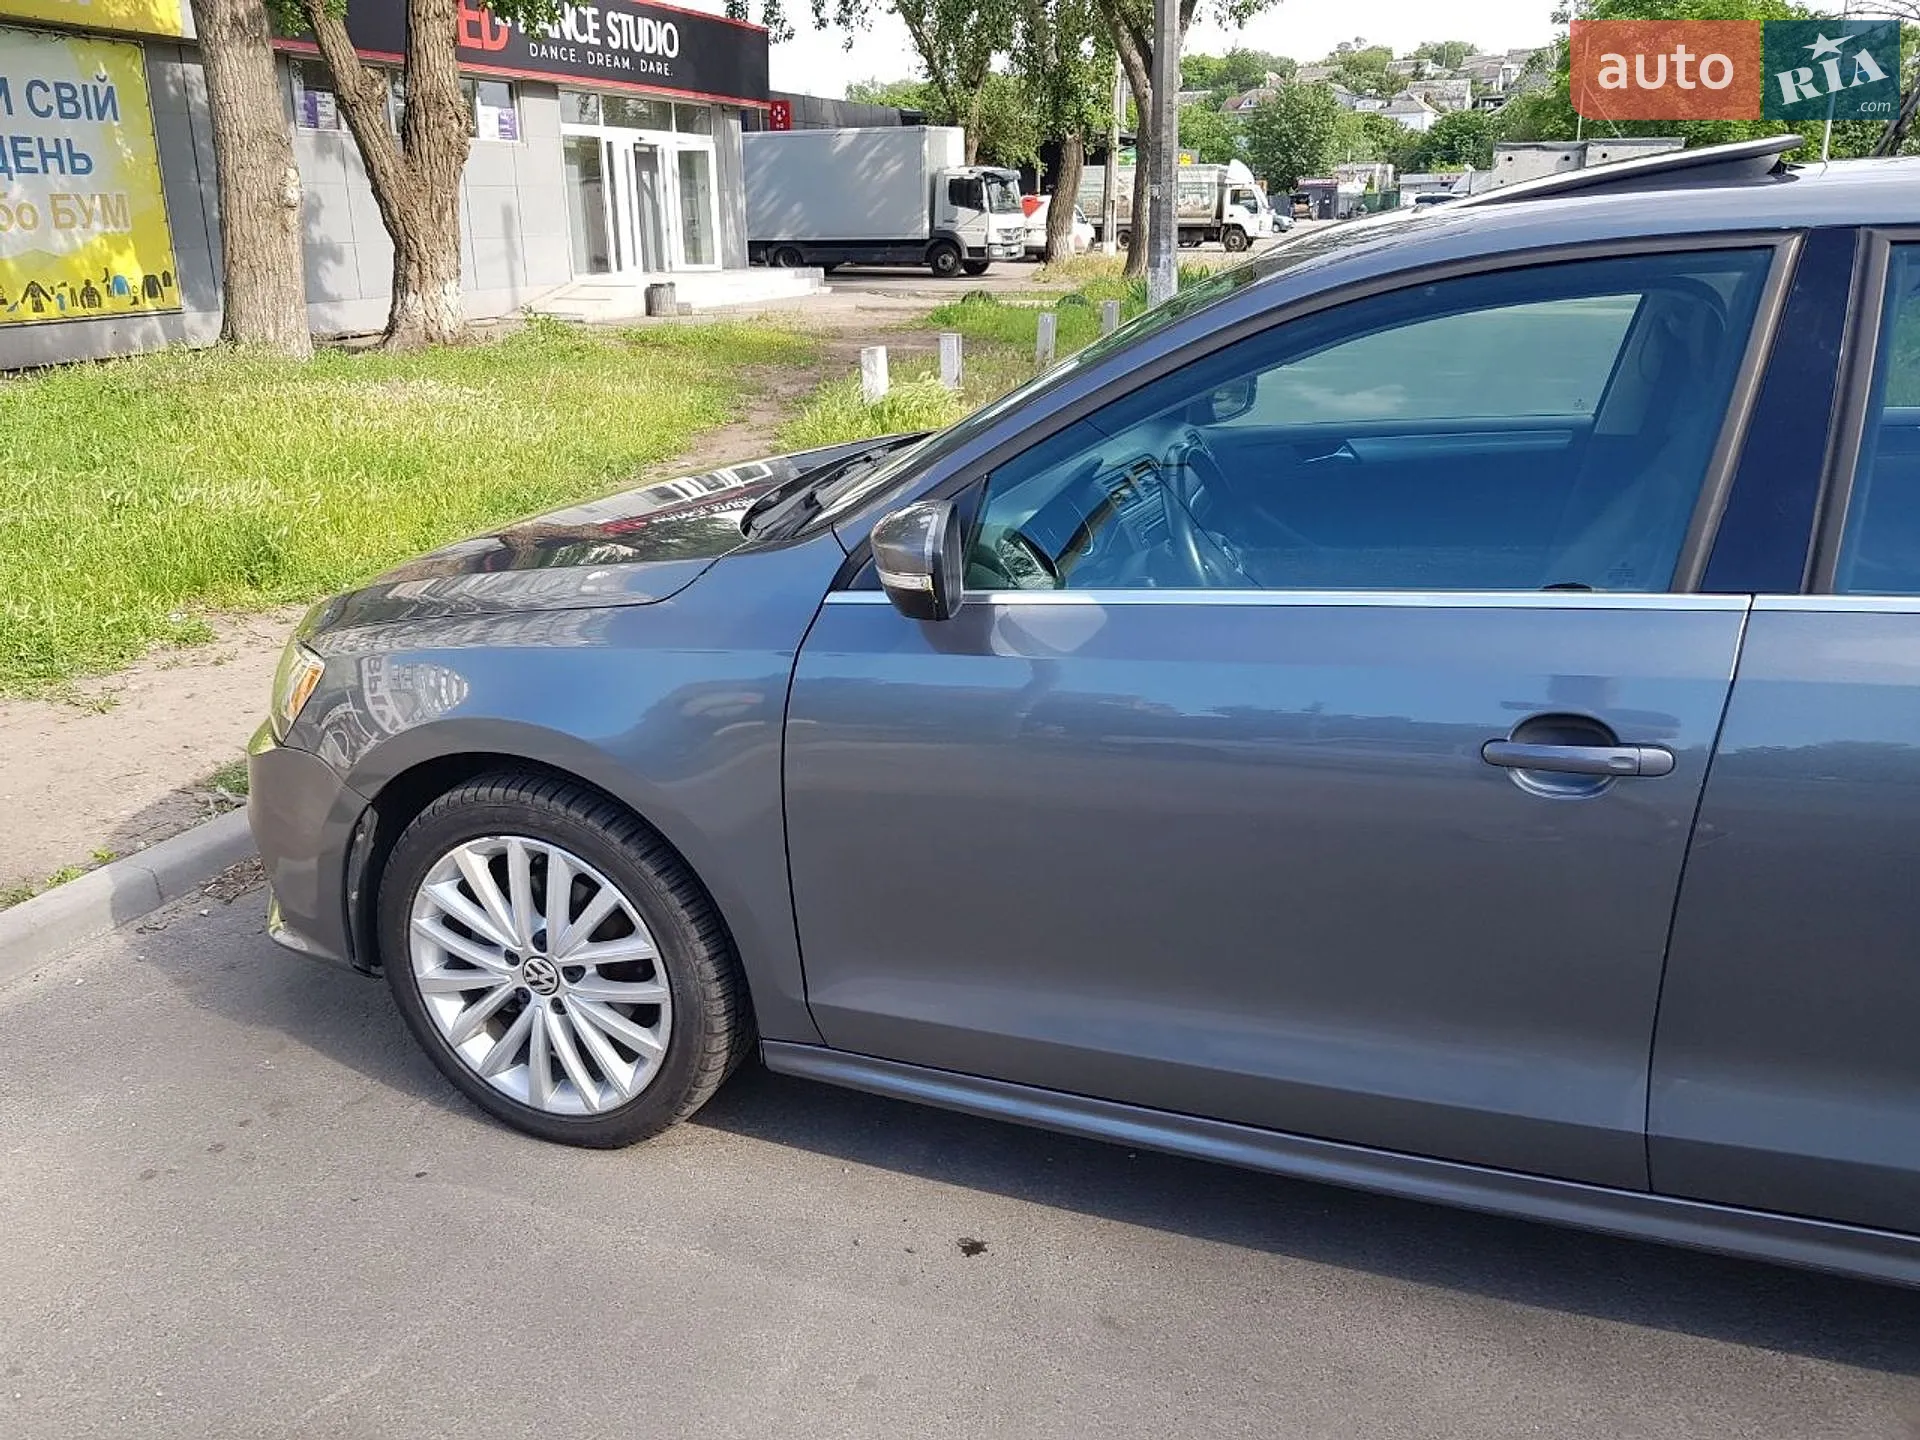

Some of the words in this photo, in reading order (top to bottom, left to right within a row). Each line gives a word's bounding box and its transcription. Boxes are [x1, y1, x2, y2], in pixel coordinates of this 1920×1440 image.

[606, 10, 679, 58] STUDIO
[529, 42, 582, 63] DANCE.
[587, 51, 634, 71] DREAM.
[640, 59, 673, 76] DARE.
[25, 74, 119, 121] СВІЙ
[50, 193, 130, 230] БУМ
